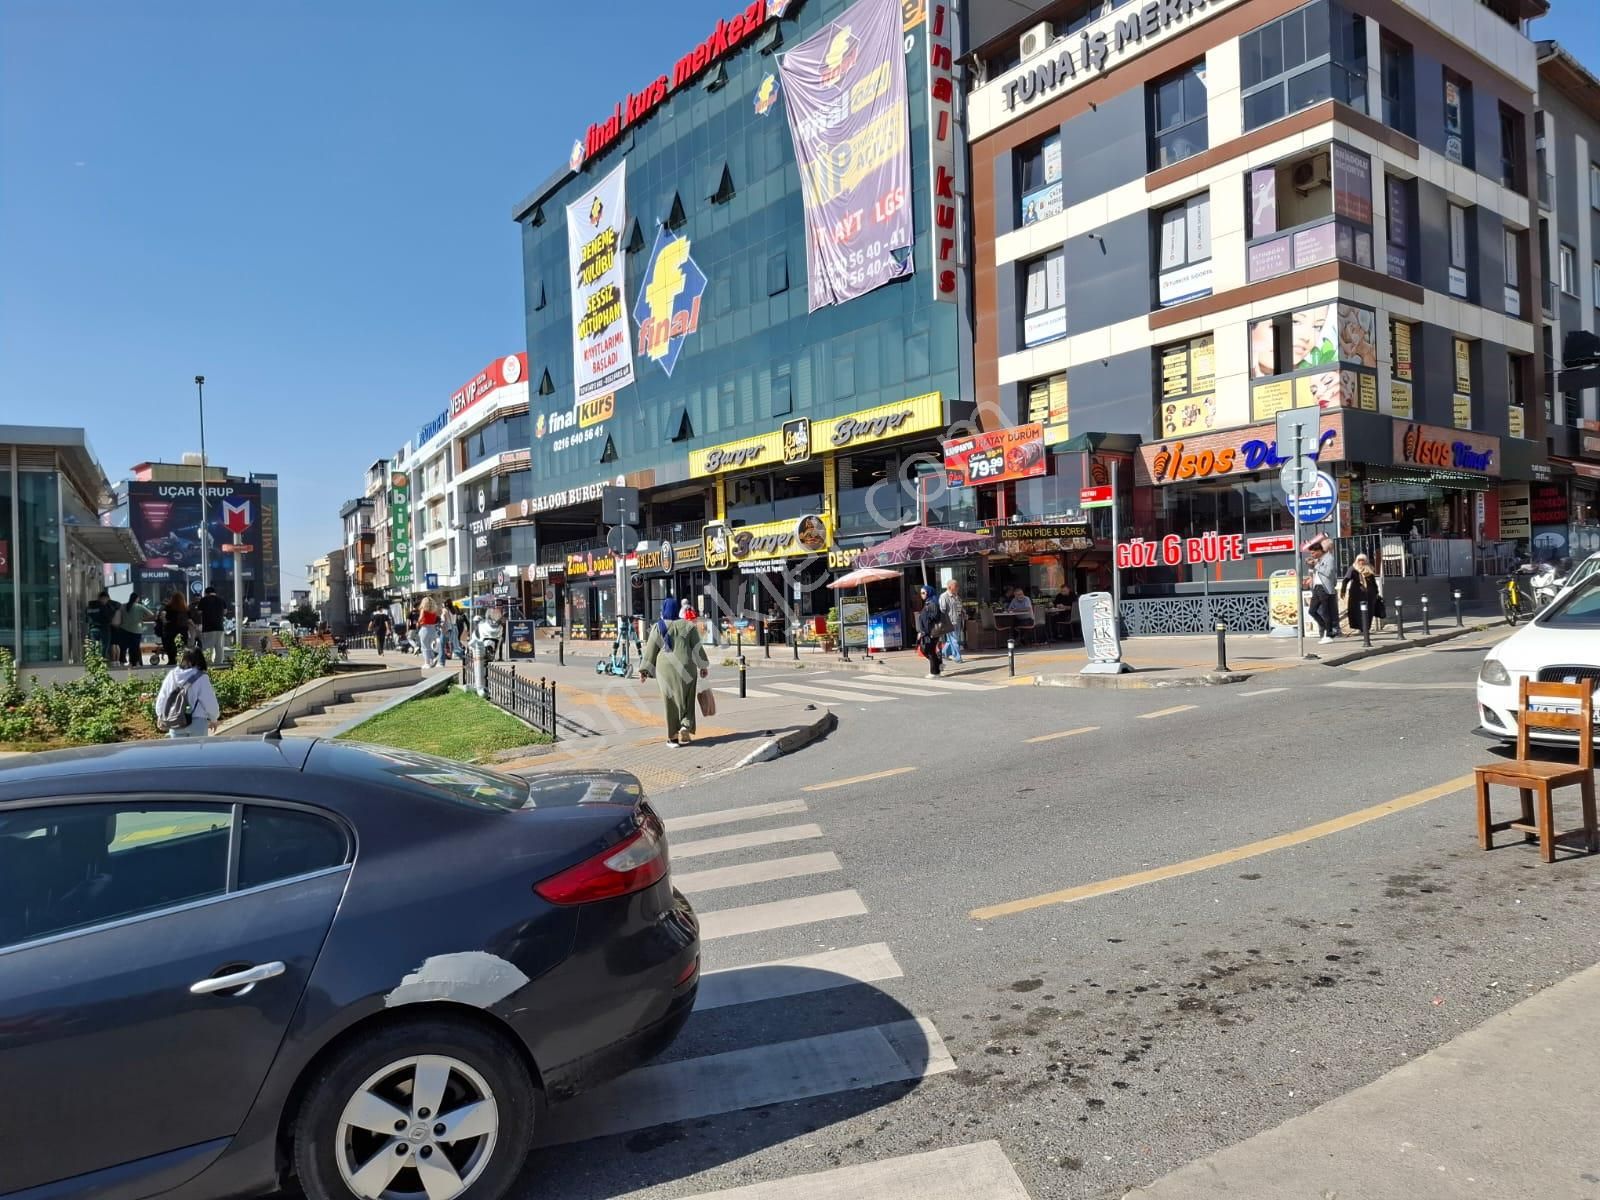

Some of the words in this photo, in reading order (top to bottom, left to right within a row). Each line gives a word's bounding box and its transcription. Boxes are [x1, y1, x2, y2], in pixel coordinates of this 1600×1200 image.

[1002, 51, 1075, 111] TUNA
[1080, 30, 1109, 71] İŞ
[584, 102, 621, 160] final
[624, 75, 668, 127] kurs
[834, 208, 864, 243] AYT
[873, 187, 905, 224] LGS
[936, 166, 956, 293] kurs
[849, 253, 864, 269] 56
[866, 242, 881, 258] 40
[587, 283, 614, 311] SESSİZ
[637, 296, 703, 357] final
[592, 353, 618, 374] BAŞLADI
[548, 404, 578, 434] final
[581, 395, 613, 421] kurs
[830, 408, 914, 446] Burger
[553, 436, 570, 453] 0216
[570, 431, 584, 447] 640
[584, 427, 594, 442] 56
[978, 435, 1005, 447] HATAY
[1007, 427, 1040, 442] DÜRÜM
[704, 444, 766, 473] Burger
[158, 485, 195, 498] UÇAR
[198, 486, 234, 497] GRUP
[531, 490, 568, 513] SALOON
[568, 481, 611, 504] BURGE
[393, 489, 409, 571] birey
[732, 530, 794, 558] Burger
[1001, 528, 1033, 538] DESTAN
[1034, 526, 1053, 537] PİDE
[1053, 527, 1060, 536] &
[1060, 525, 1087, 536] BÖREK
[593, 555, 615, 572] DÜRÜM
[1116, 537, 1158, 569] GÖZ
[1162, 534, 1182, 567] 6
[1186, 531, 1245, 564] BÜFE
